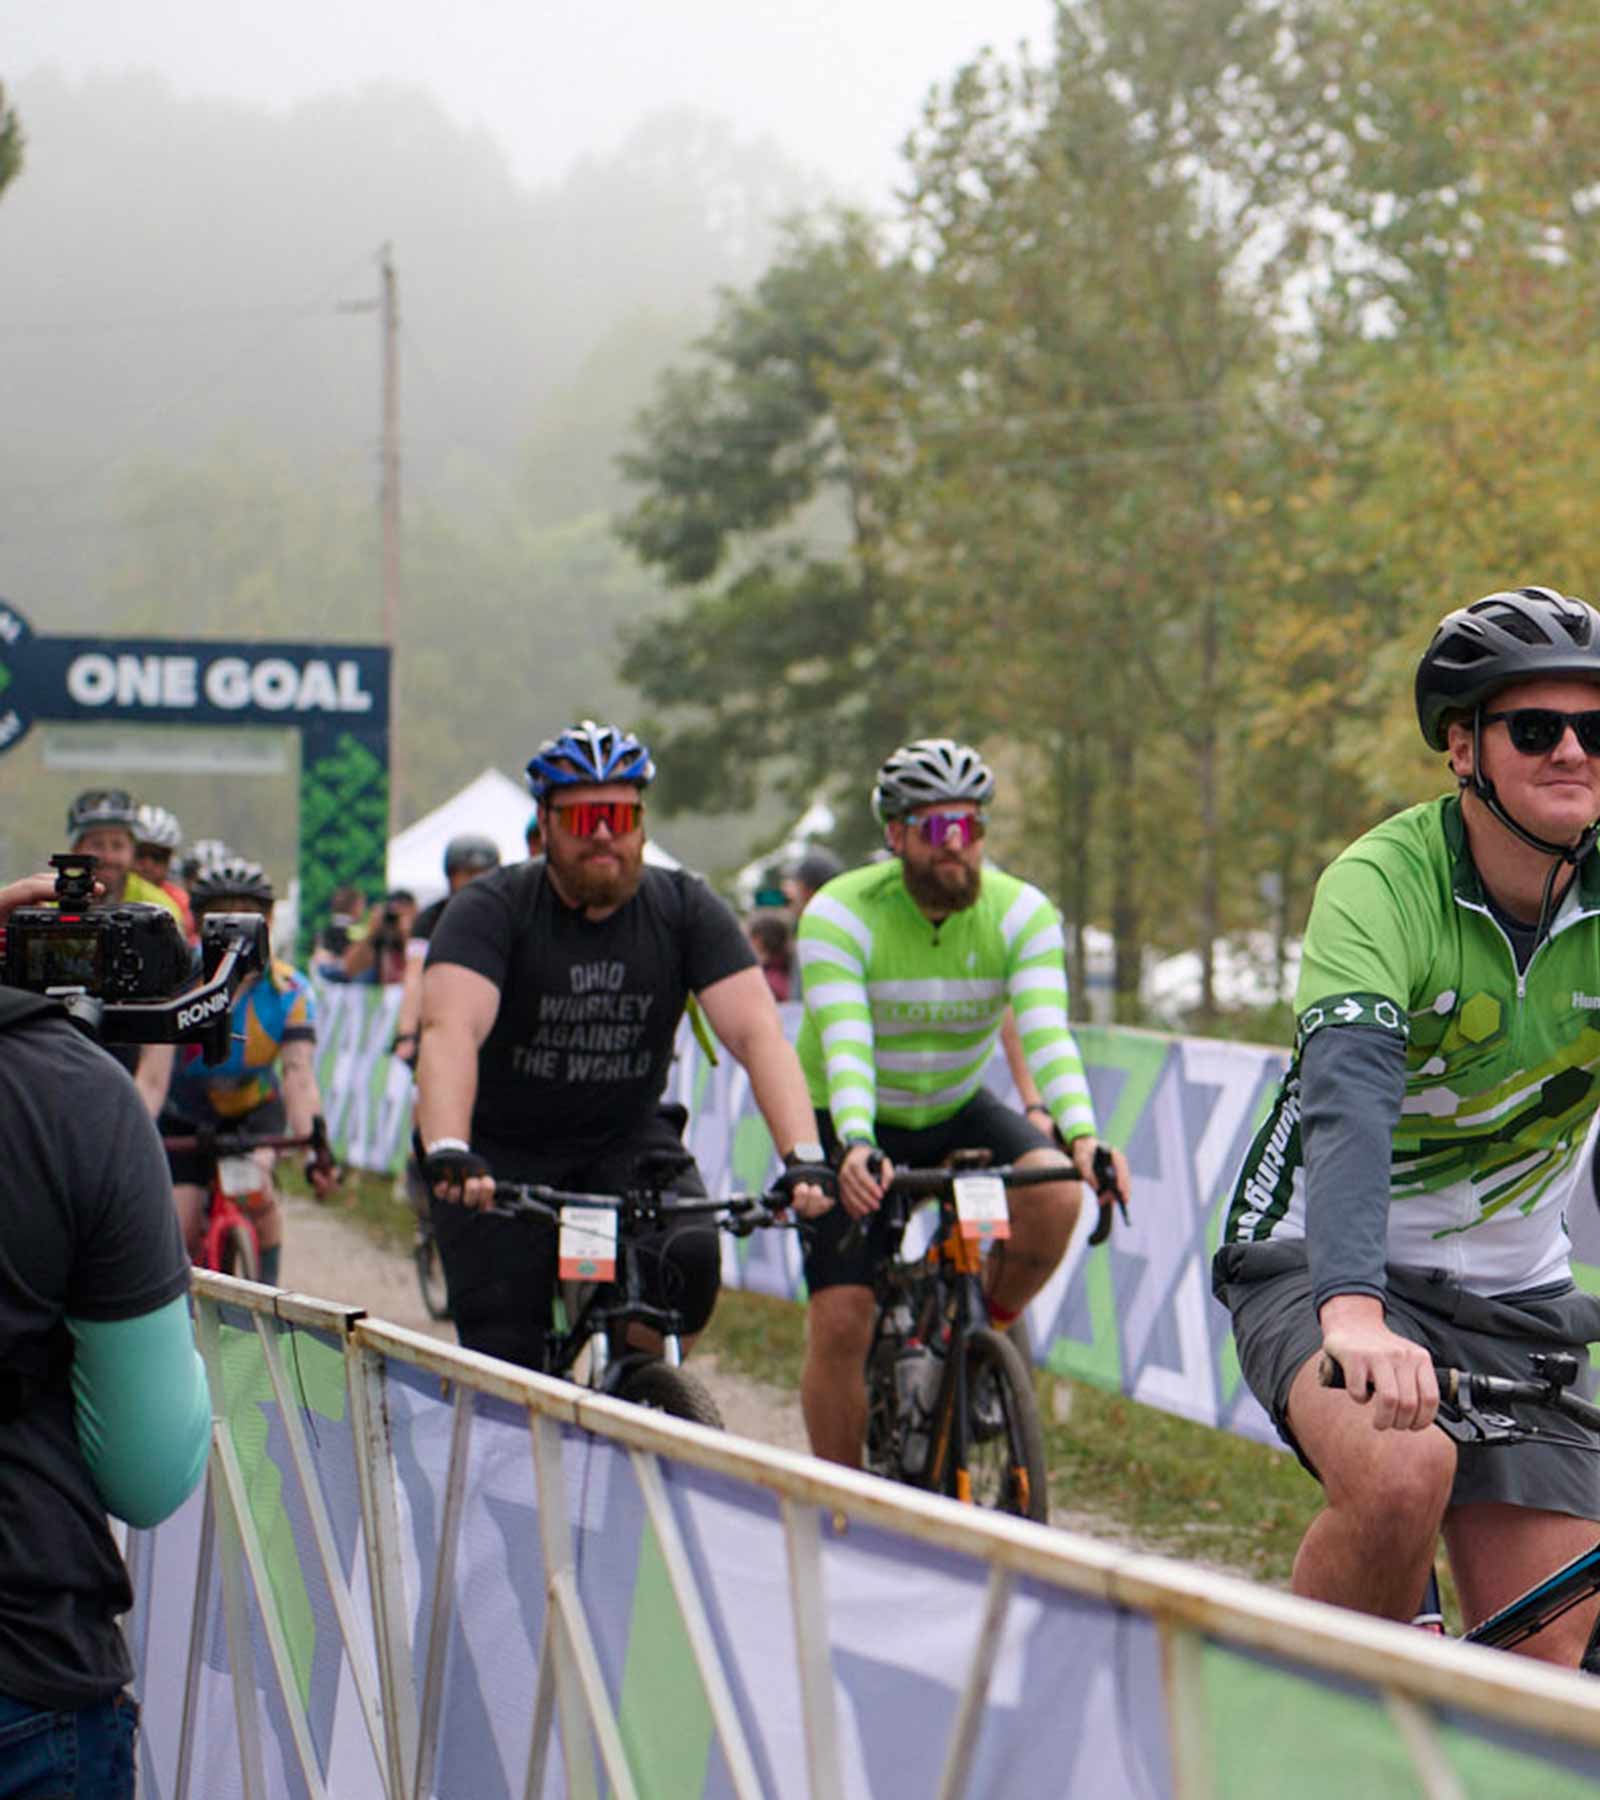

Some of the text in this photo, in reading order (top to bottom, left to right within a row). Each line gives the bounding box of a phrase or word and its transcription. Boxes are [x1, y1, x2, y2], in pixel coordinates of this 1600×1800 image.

[66, 653, 372, 712] ONE GOAL
[570, 961, 625, 993] OHIO
[177, 990, 232, 1030] RONIN
[538, 993, 654, 1021] WHISKEY
[529, 1023, 647, 1051] AGAINST
[511, 1046, 653, 1083] THE WORLD
